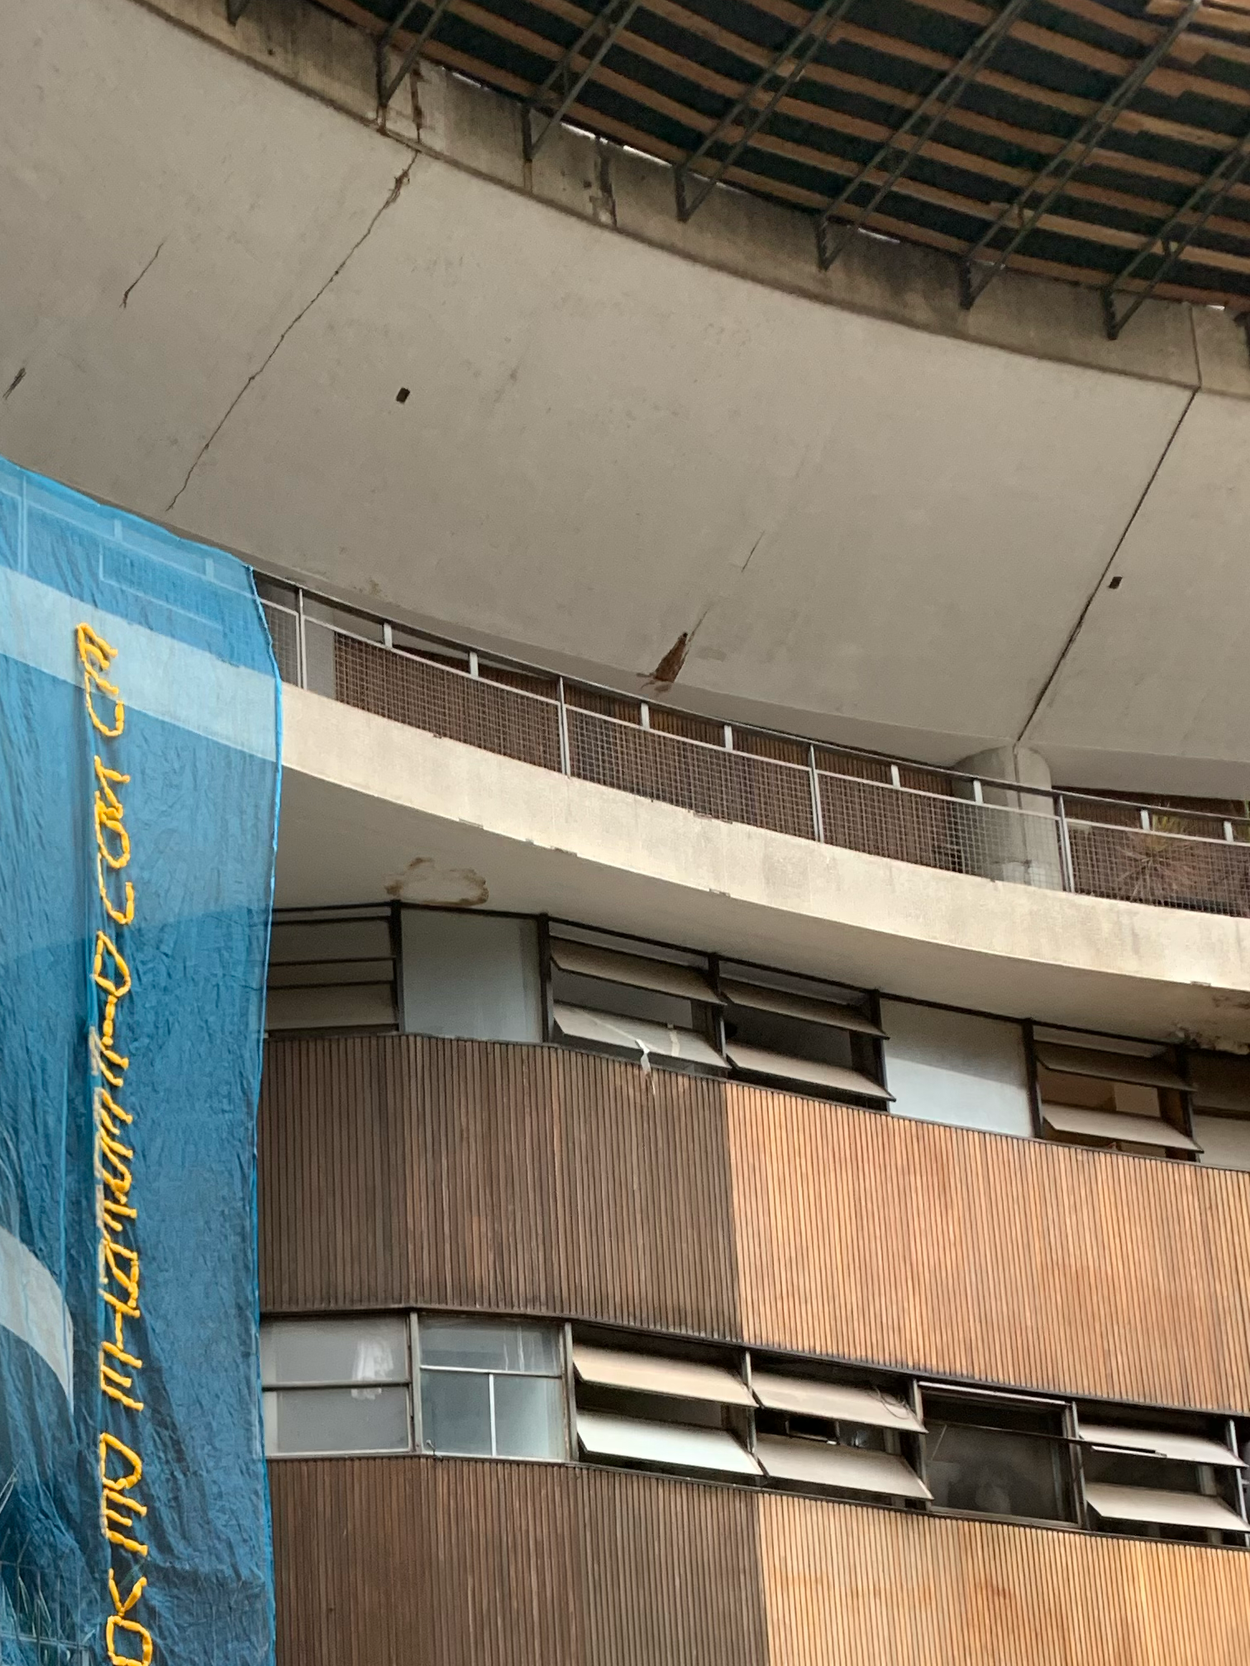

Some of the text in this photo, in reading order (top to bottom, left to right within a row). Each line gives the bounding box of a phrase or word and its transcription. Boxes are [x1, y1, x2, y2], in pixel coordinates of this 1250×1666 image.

[76, 622, 125, 738] EU
[94, 754, 135, 926] SOU
[88, 930, 145, 1412] DIFERENTE
[98, 1432, 148, 1556] DE
